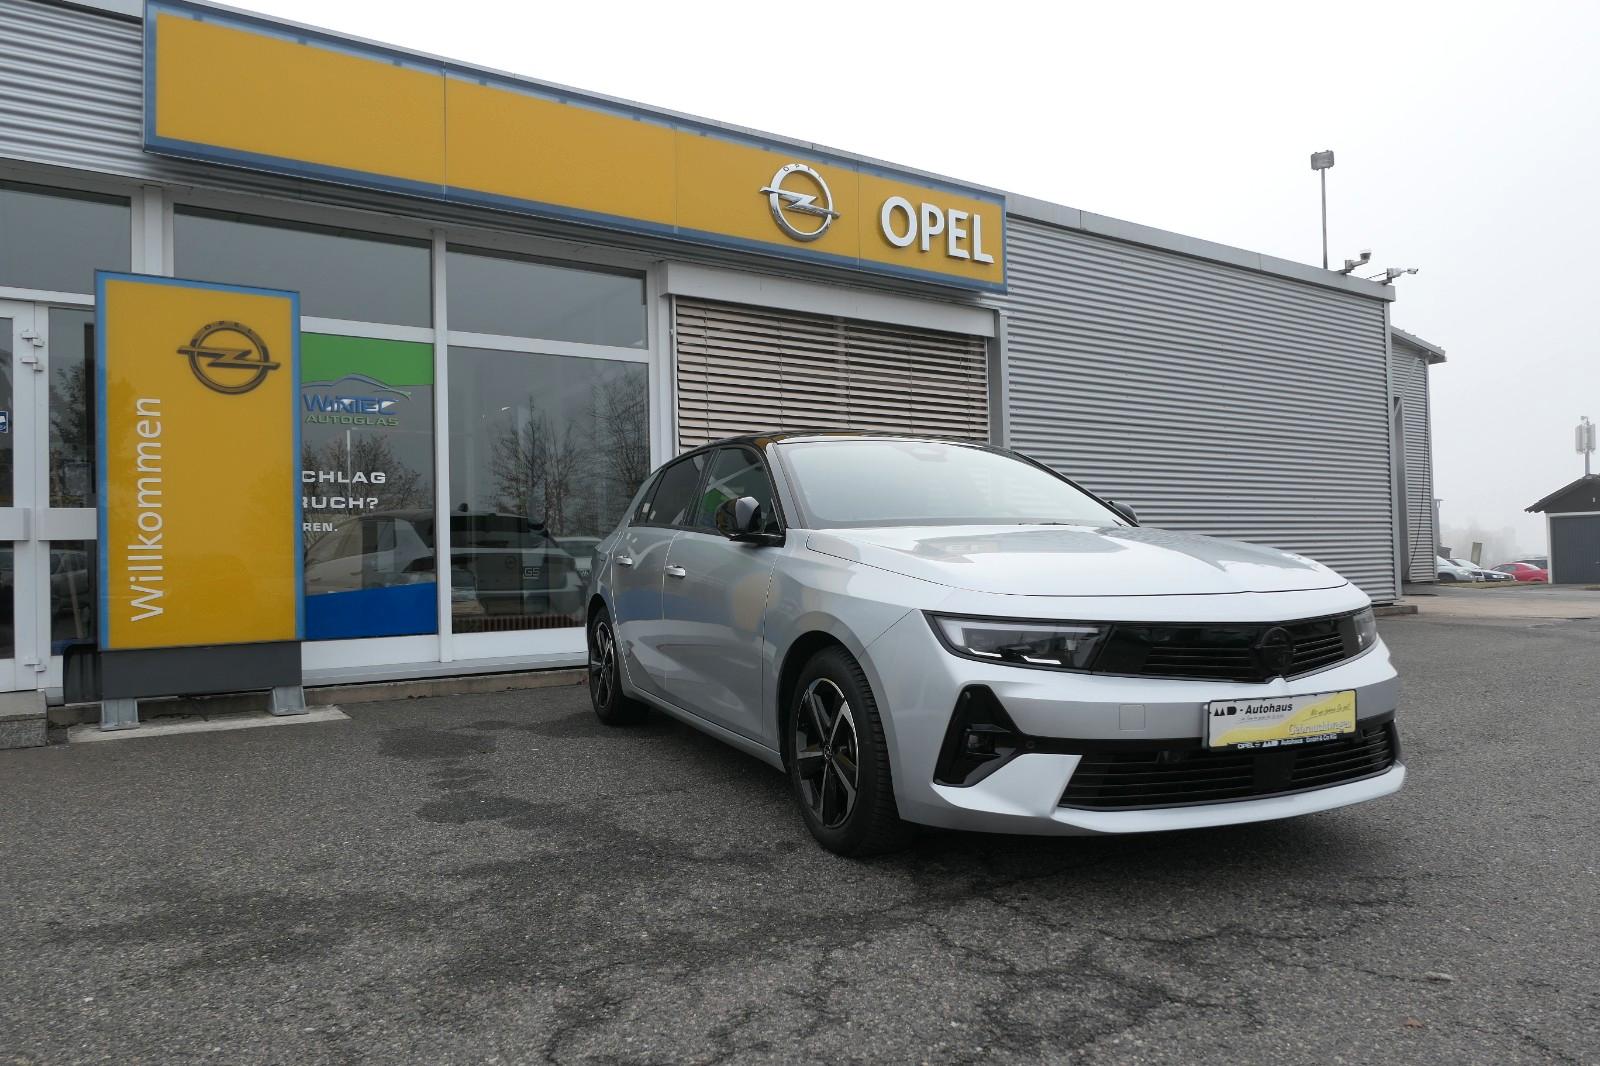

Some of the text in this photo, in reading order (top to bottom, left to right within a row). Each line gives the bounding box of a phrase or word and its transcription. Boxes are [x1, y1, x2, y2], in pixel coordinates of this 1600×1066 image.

[881, 195, 994, 264] OPEL
[305, 415, 400, 426] AUTOGLAS
[127, 397, 163, 622] Willkommen
[1244, 703, 1293, 715] Autohaus
